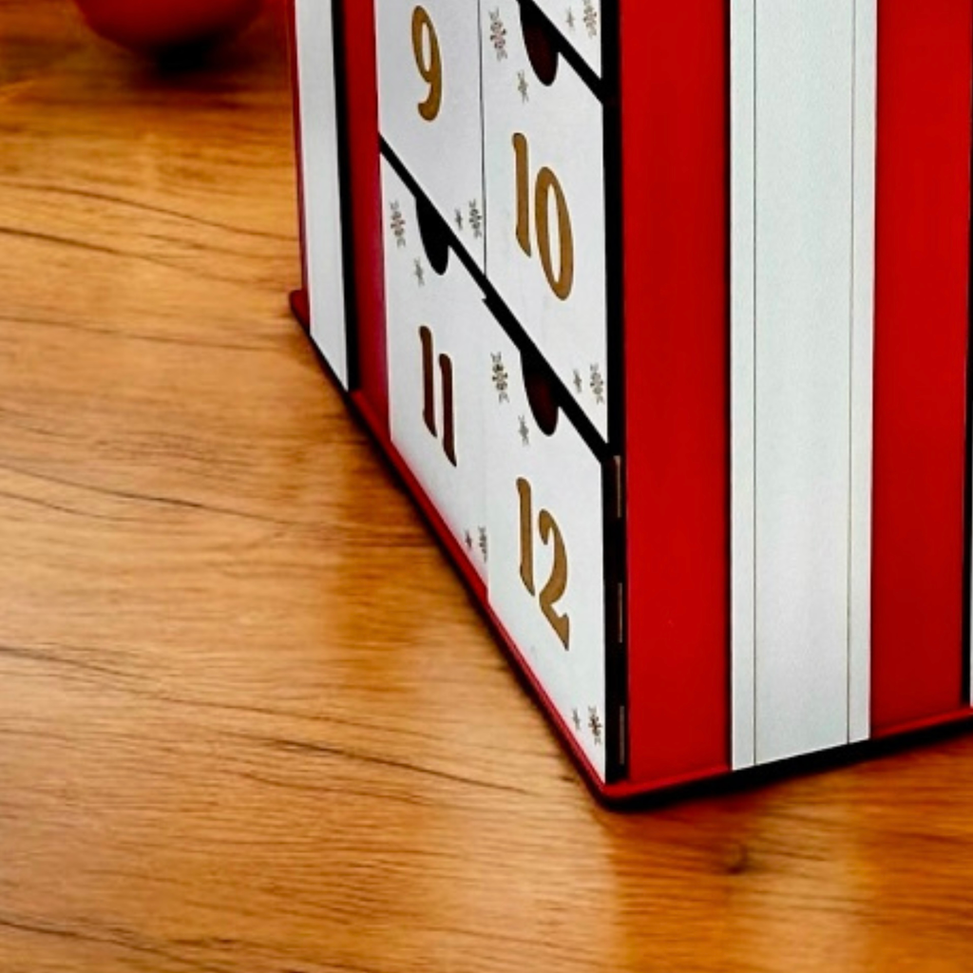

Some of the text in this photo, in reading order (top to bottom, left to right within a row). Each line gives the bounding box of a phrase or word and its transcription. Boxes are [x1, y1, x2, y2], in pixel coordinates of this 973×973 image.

[412, 6, 442, 121] 9
[512, 133, 573, 300] 10
[419, 326, 457, 467] 11
[516, 477, 569, 651] 12
